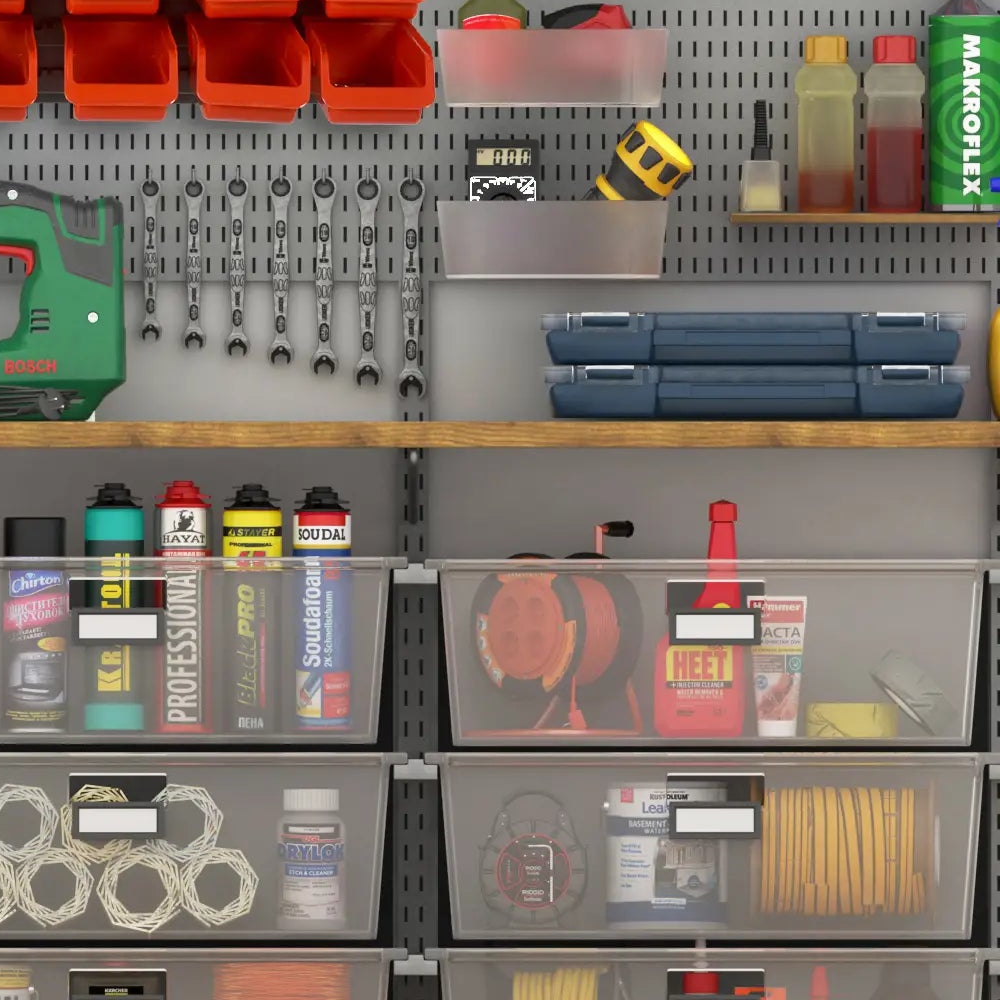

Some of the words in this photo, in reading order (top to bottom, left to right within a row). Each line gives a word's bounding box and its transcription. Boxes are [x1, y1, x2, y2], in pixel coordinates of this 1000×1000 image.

[962, 34, 981, 196] MAKROFLEX
[4, 359, 57, 374] BOSCH
[163, 535, 205, 543] HAYAT
[237, 528, 275, 536] STAYER
[298, 528, 346, 540] SOUDAL
[12, 576, 60, 593] Chirton
[303, 556, 321, 667] Soudafoam
[763, 627, 800, 638] АСТА
[167, 569, 197, 722] PROFESSIONAL
[673, 650, 728, 680] HEET
[238, 717, 264, 729] ПЕНА
[277, 842, 344, 861] DRYLOK
